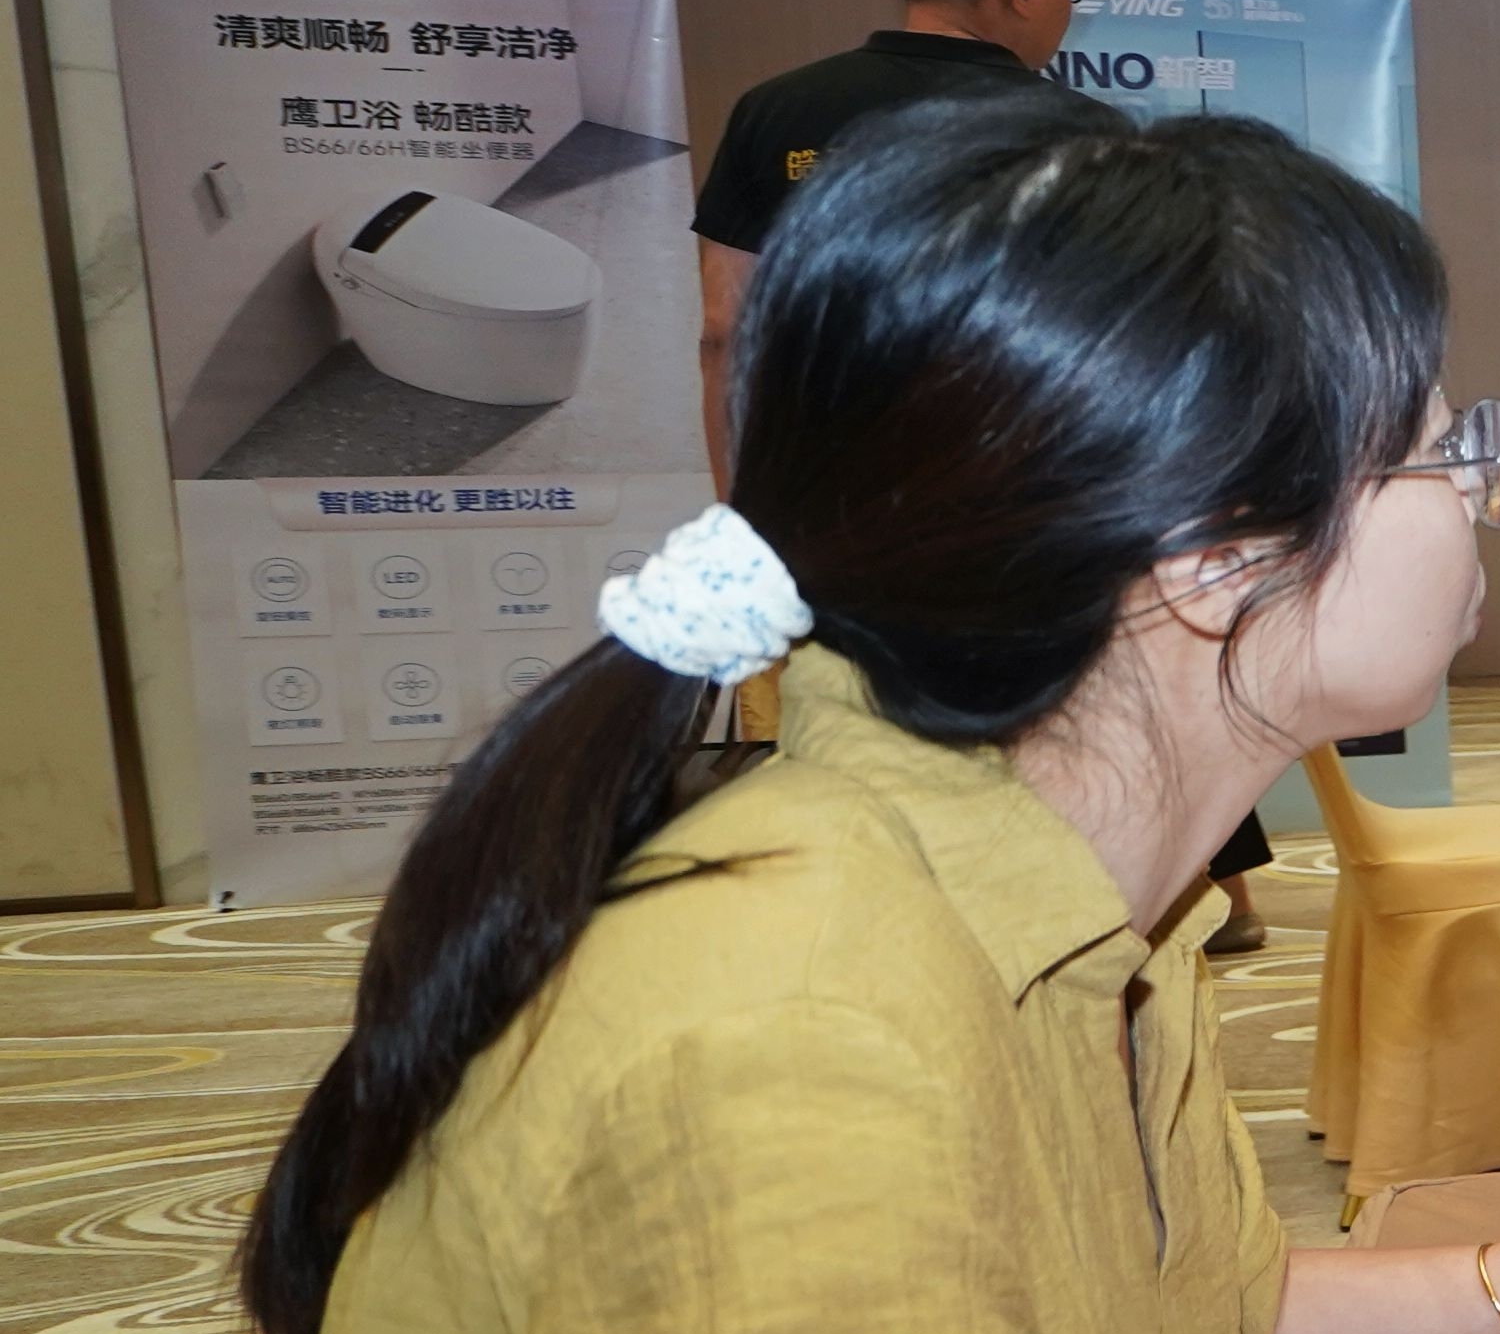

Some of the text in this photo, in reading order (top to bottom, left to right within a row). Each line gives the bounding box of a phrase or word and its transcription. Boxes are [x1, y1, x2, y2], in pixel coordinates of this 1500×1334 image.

[214, 13, 578, 60] 清爽顺畅 舒享洁净
[280, 97, 534, 134] 鹰卫浴 畅酷款
[317, 488, 576, 515] 智能进化 更胜以往
[383, 572, 420, 584] LED
